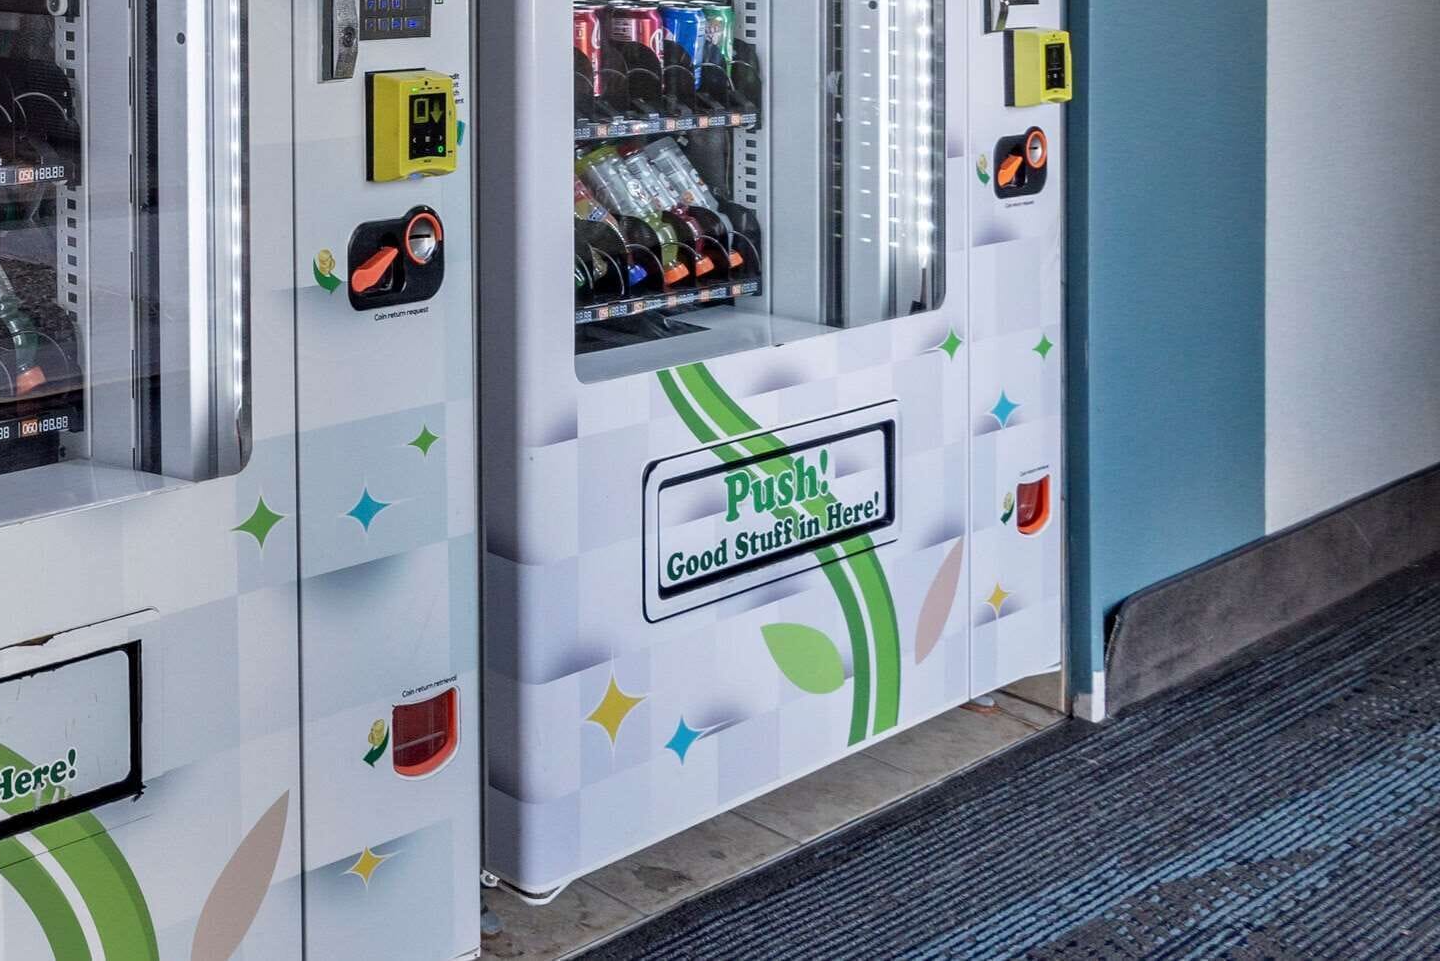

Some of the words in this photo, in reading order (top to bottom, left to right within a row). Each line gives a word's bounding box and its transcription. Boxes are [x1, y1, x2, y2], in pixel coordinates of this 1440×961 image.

[375, 313, 387, 321] Coin
[407, 306, 429, 316] request
[723, 448, 829, 522] Push!
[667, 538, 727, 582] Good
[735, 517, 793, 560] Stuff
[799, 514, 820, 540] in
[826, 491, 880, 532] Here!
[402, 690, 415, 698] Coin
[416, 684, 433, 694] return
